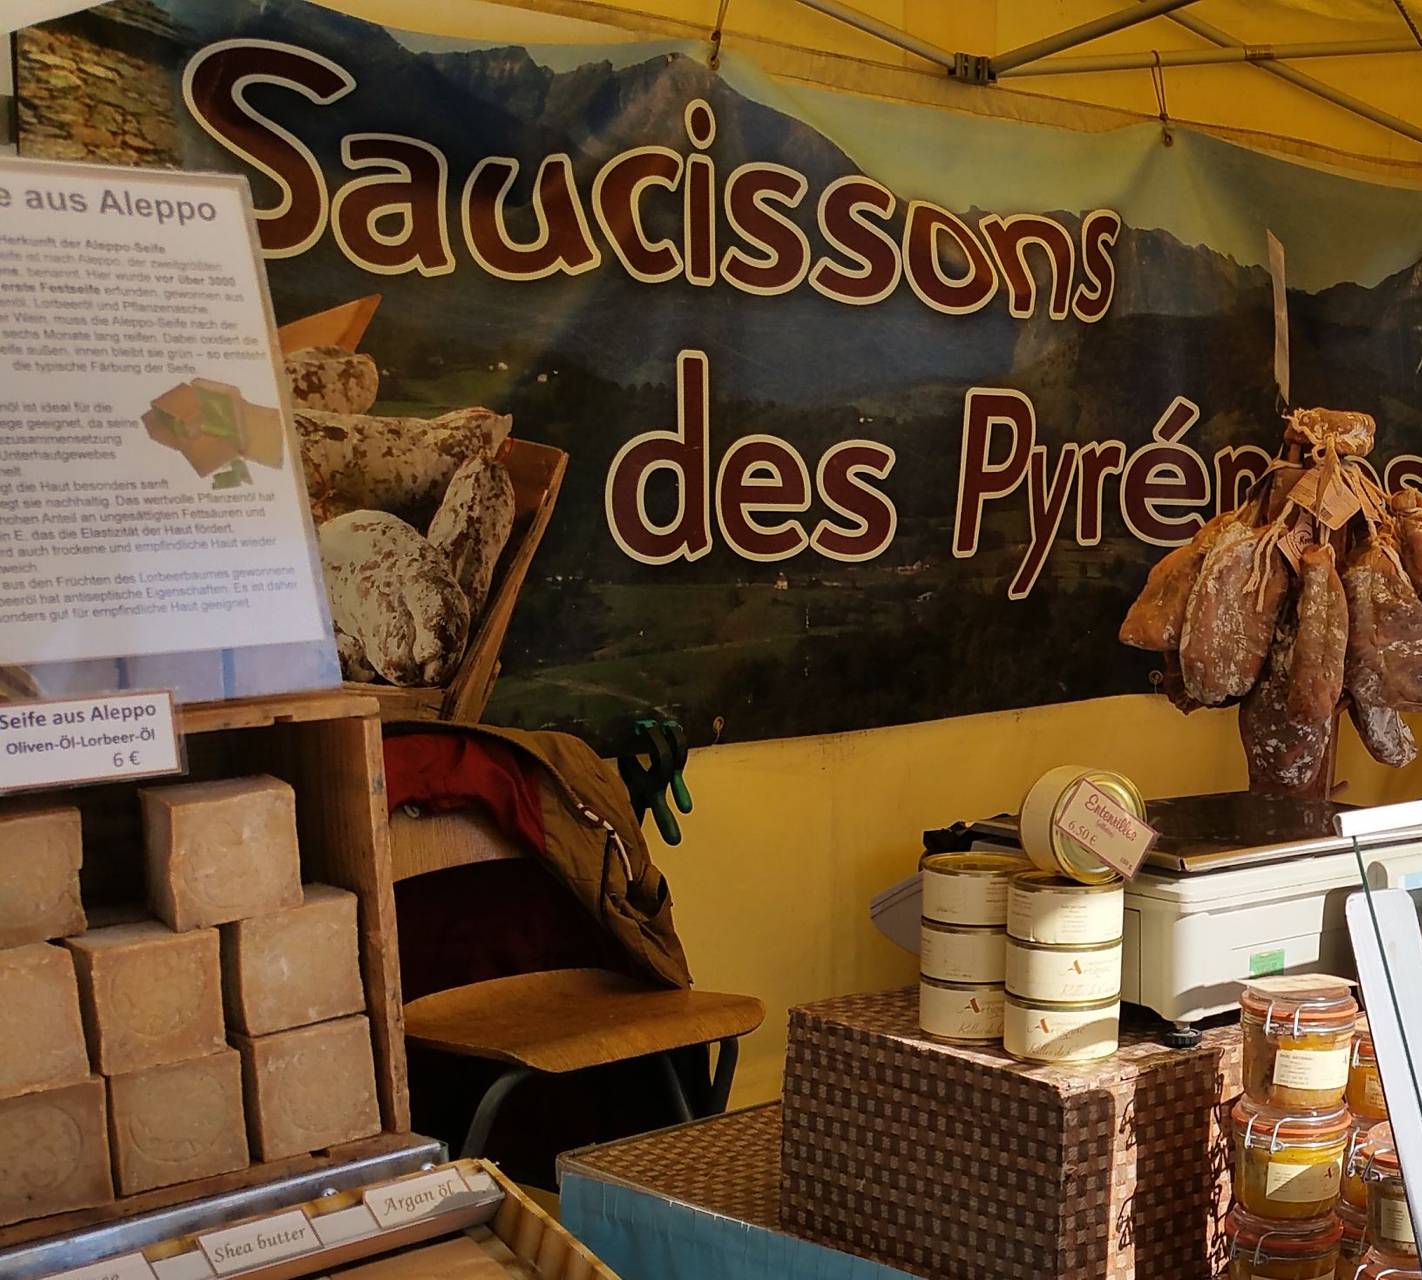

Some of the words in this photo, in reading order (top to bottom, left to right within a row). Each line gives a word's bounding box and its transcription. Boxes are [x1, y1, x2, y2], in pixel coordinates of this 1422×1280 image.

[183, 40, 1121, 323] Saucissons
[25, 190, 88, 212] aus
[100, 189, 216, 225] Aleppo
[607, 350, 896, 564] des
[0, 711, 46, 730] Seife
[52, 711, 85, 725] aus
[91, 704, 157, 722] Aleppo
[6, 728, 155, 755] Oliven-Öl-Lorbeer-Öl
[113, 752, 124, 768] 6
[129, 751, 140, 765] €
[384, 1190, 434, 1216] Argan
[439, 1180, 453, 1198] öl
[214, 1244, 253, 1264] Shea
[257, 1227, 306, 1250] butter
